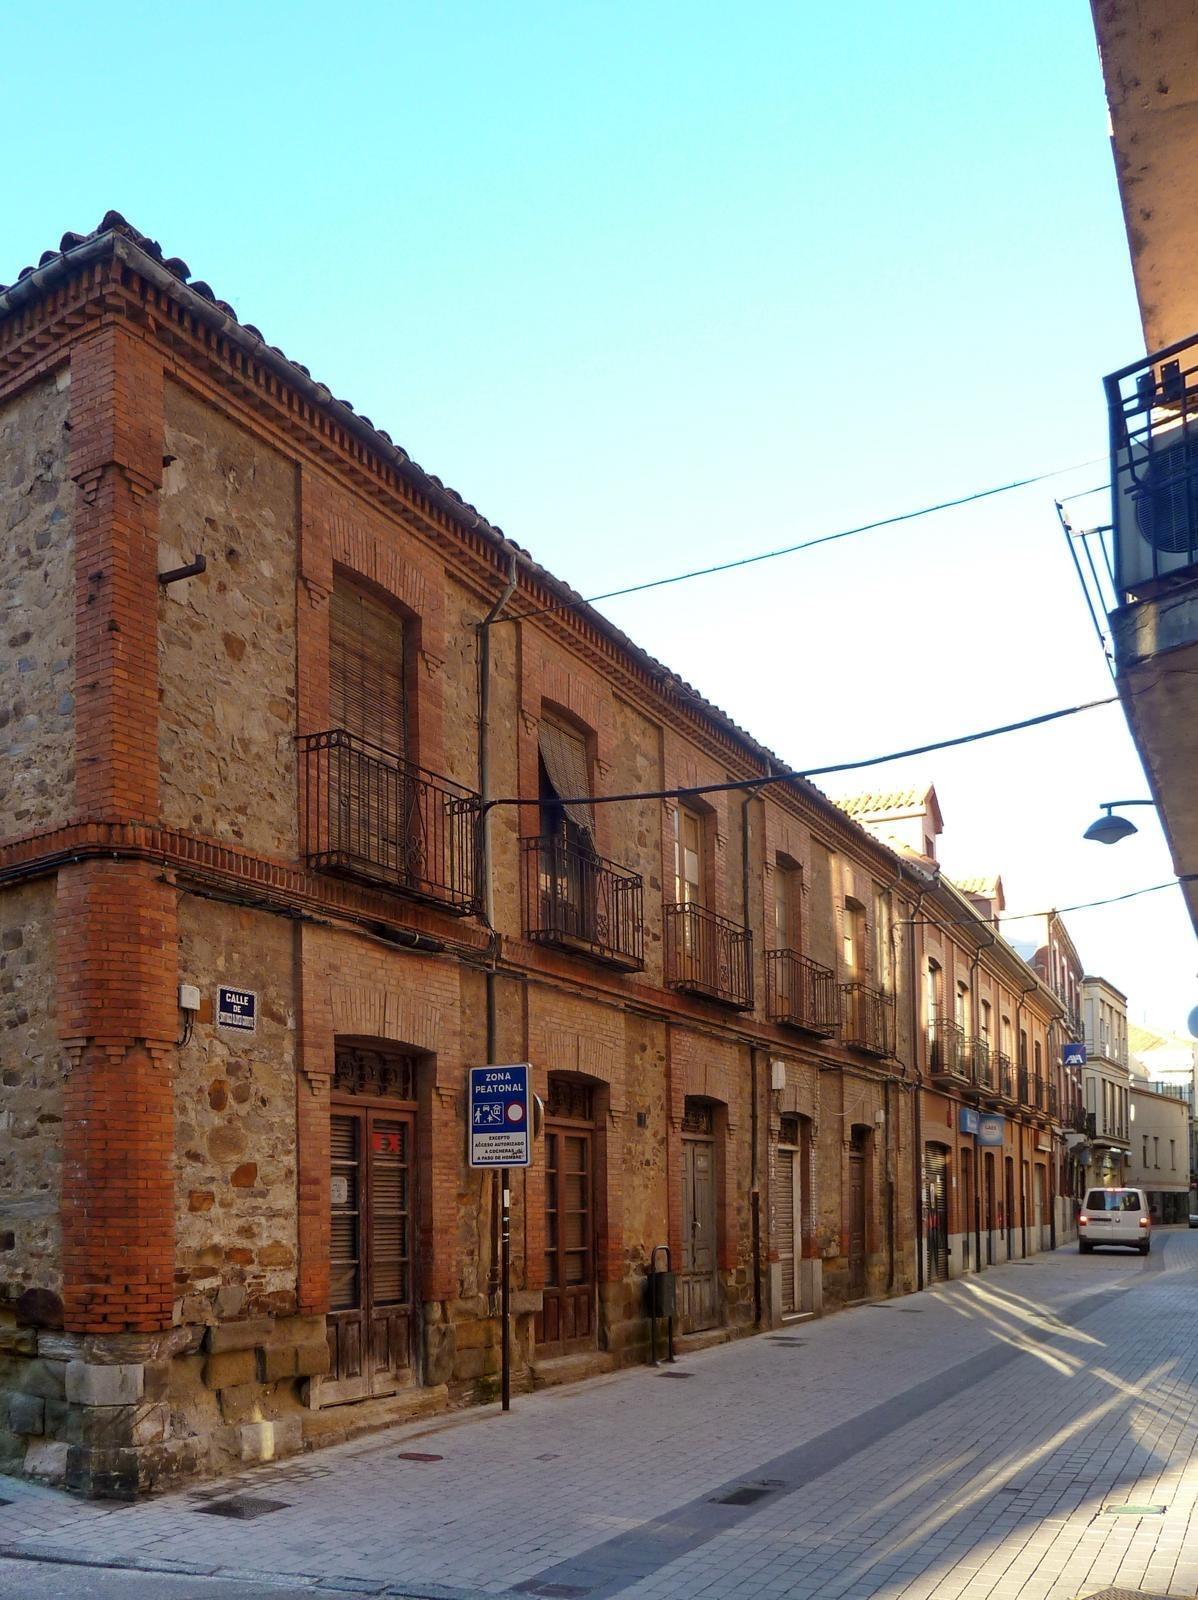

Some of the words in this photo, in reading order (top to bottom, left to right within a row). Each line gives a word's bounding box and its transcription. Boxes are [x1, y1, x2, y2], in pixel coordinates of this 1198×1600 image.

[225, 993, 249, 1006] CALLE
[233, 1005, 242, 1013] DE
[486, 1072, 511, 1082] ZONA
[475, 1083, 523, 1094] PEATONAL
